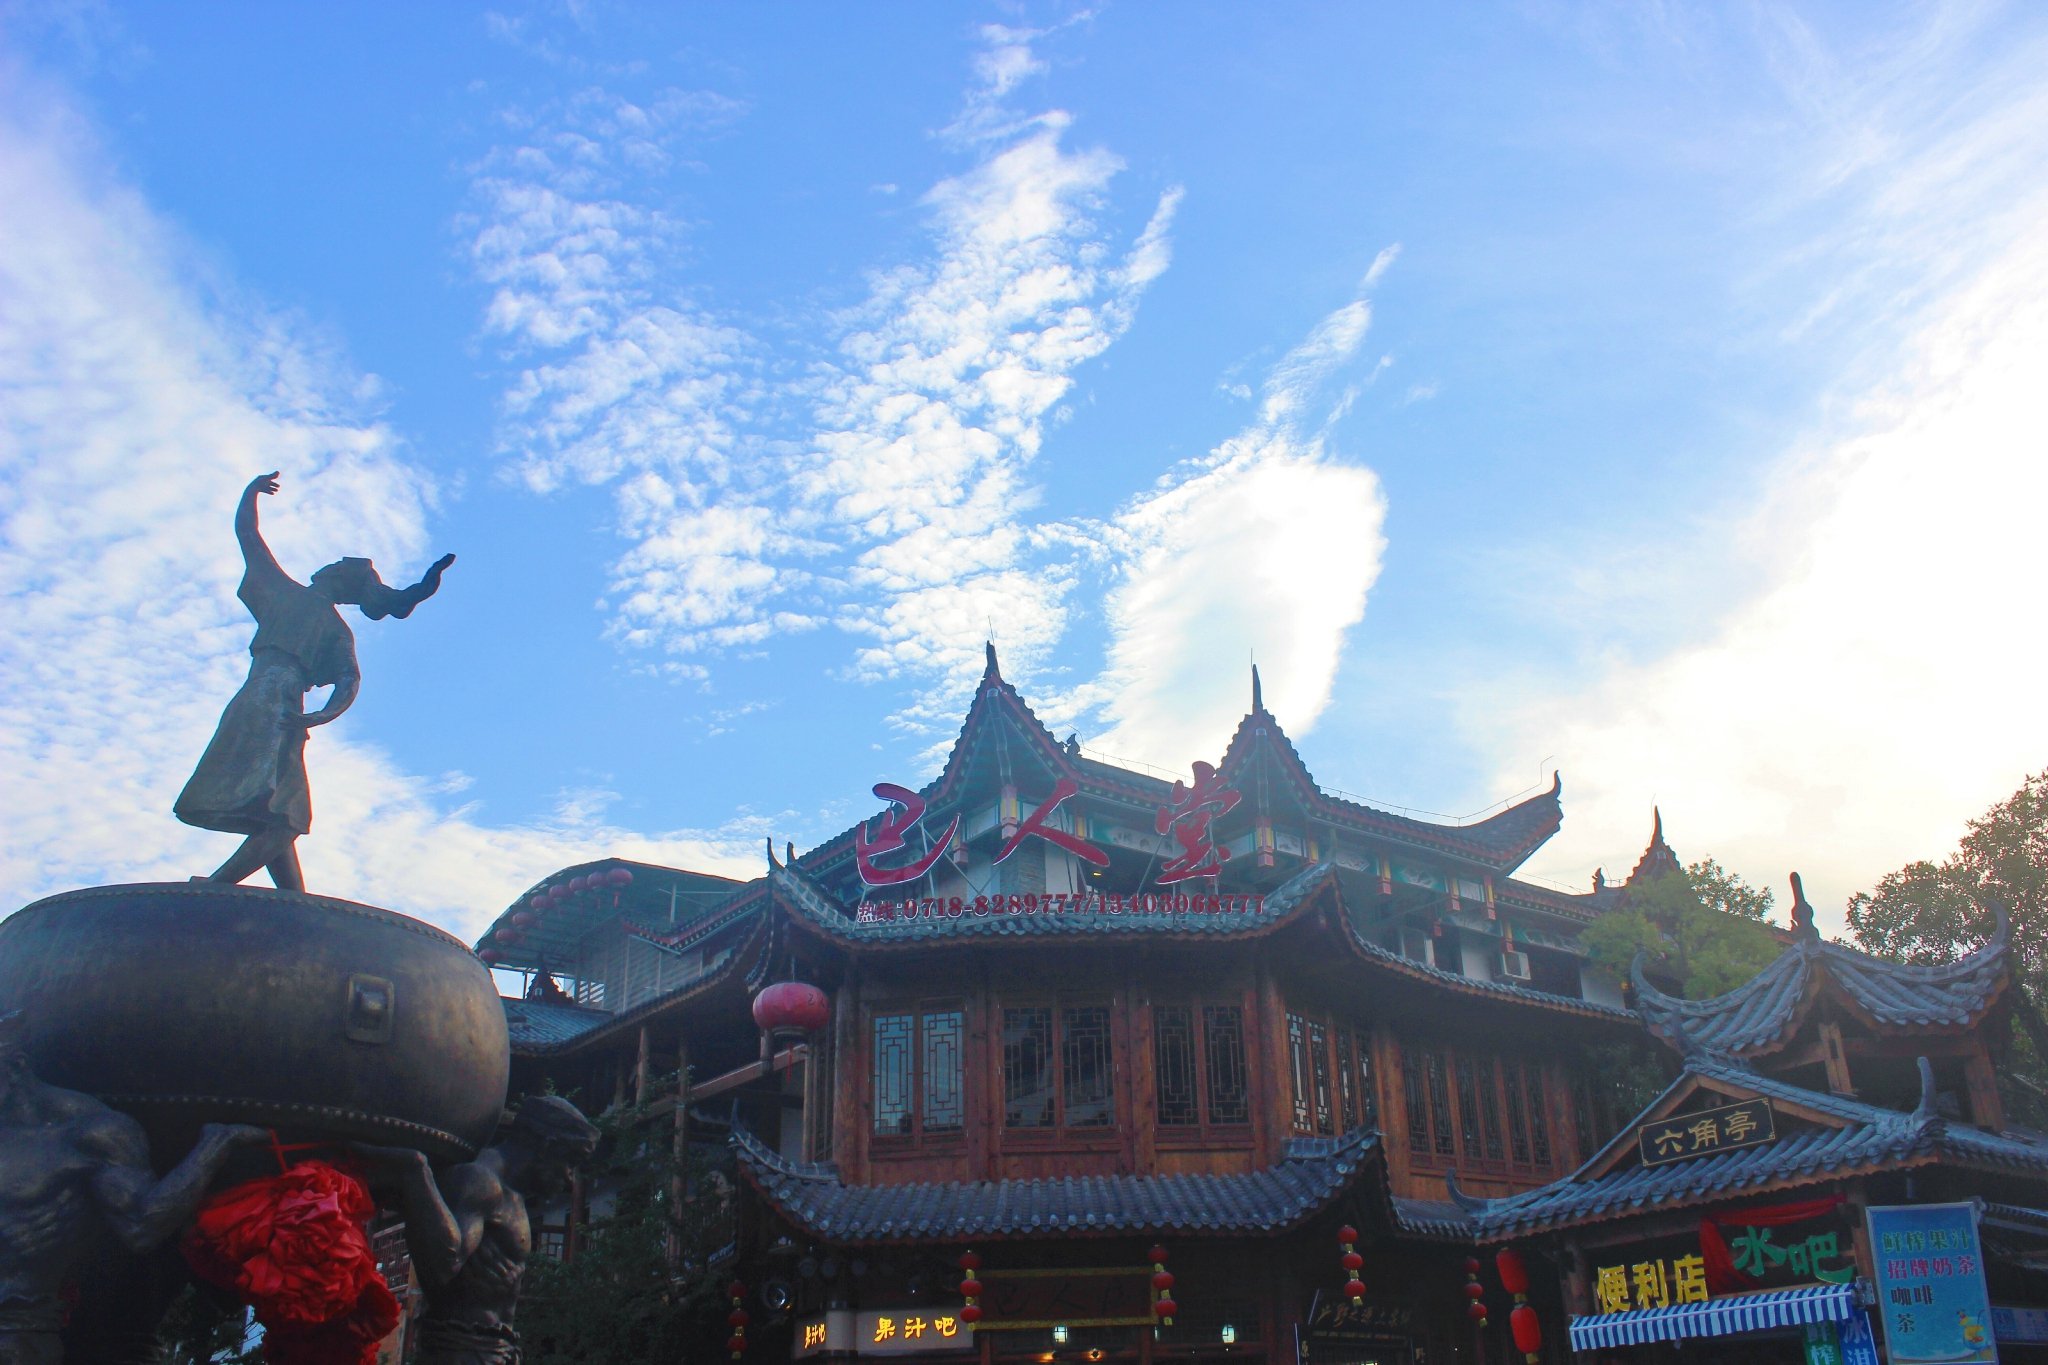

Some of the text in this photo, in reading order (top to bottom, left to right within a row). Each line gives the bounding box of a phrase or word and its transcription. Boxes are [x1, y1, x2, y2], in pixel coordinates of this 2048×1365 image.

[1654, 1111, 1758, 1156] 六角亭
[1882, 1227, 1970, 1252] 鲜榨果汁
[1731, 1225, 1857, 1285] 水吧
[1887, 1255, 1976, 1280] 招牌奶茶
[1596, 1254, 1709, 1314] 便利店
[1890, 1285, 1934, 1306] 咖啡
[873, 1316, 958, 1343] 果汁吧
[1896, 1312, 1915, 1333] 茶
[803, 1323, 827, 1350] 果汁吧
